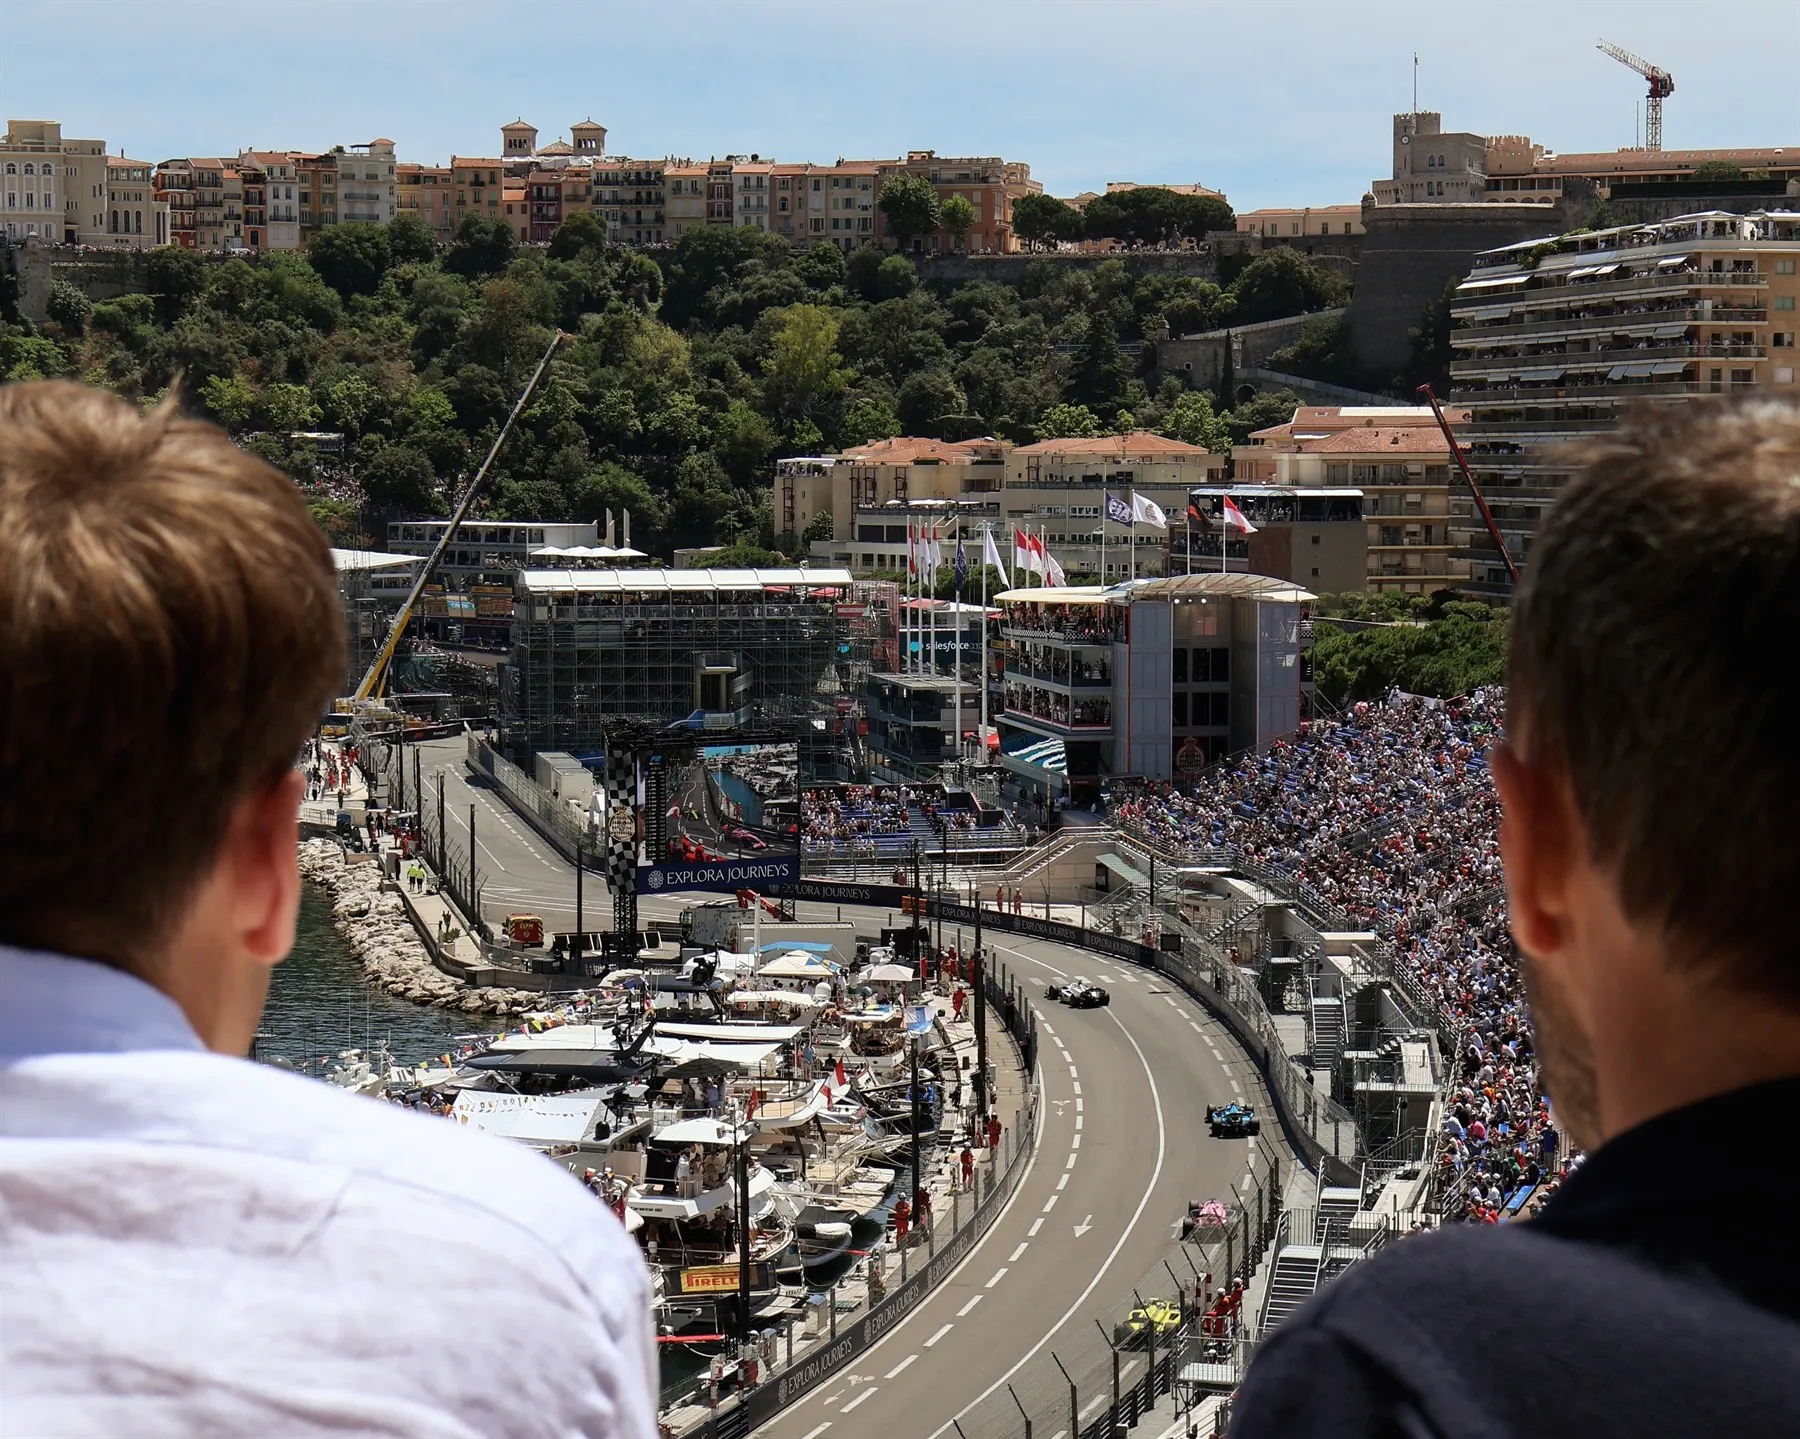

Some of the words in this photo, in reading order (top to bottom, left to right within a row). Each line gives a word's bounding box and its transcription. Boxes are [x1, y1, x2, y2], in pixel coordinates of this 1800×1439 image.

[925, 640, 969, 653] slesfoce
[667, 868, 724, 885] EXPLORA
[727, 863, 789, 883] JOURNEYS
[822, 885, 871, 900] JOURNEYS
[942, 906, 970, 920] EXPLORA
[1021, 920, 1048, 933] EXPLORA
[686, 1271, 739, 1288] PIRELL
[788, 1361, 820, 1394] EXPLORA
[820, 1336, 853, 1377] JOURNEYS
